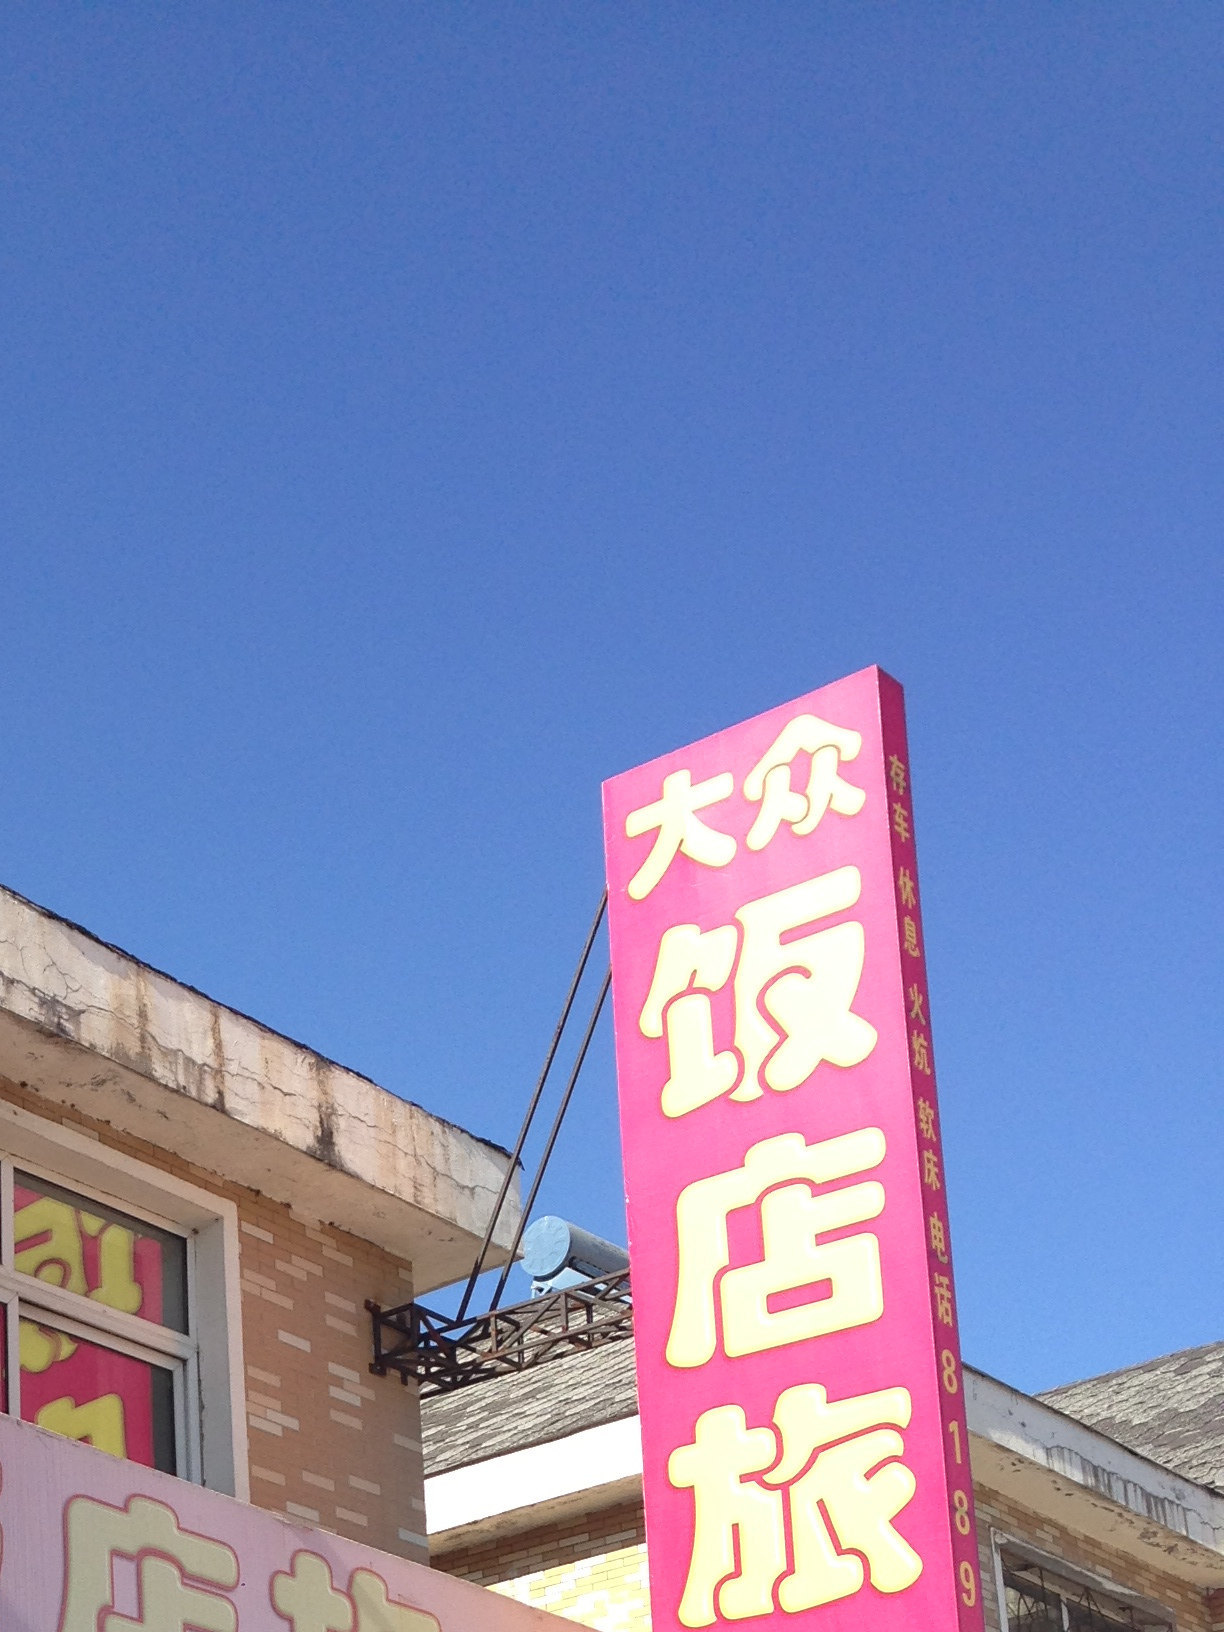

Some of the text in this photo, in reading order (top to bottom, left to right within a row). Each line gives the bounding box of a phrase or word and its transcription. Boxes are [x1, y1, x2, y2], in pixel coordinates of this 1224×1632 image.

[625, 713, 866, 901] 大众
[888, 754, 912, 843] 存车
[898, 865, 922, 958] 休息
[917, 1094, 942, 1191] 软床
[928, 1211, 955, 1328] 电话
